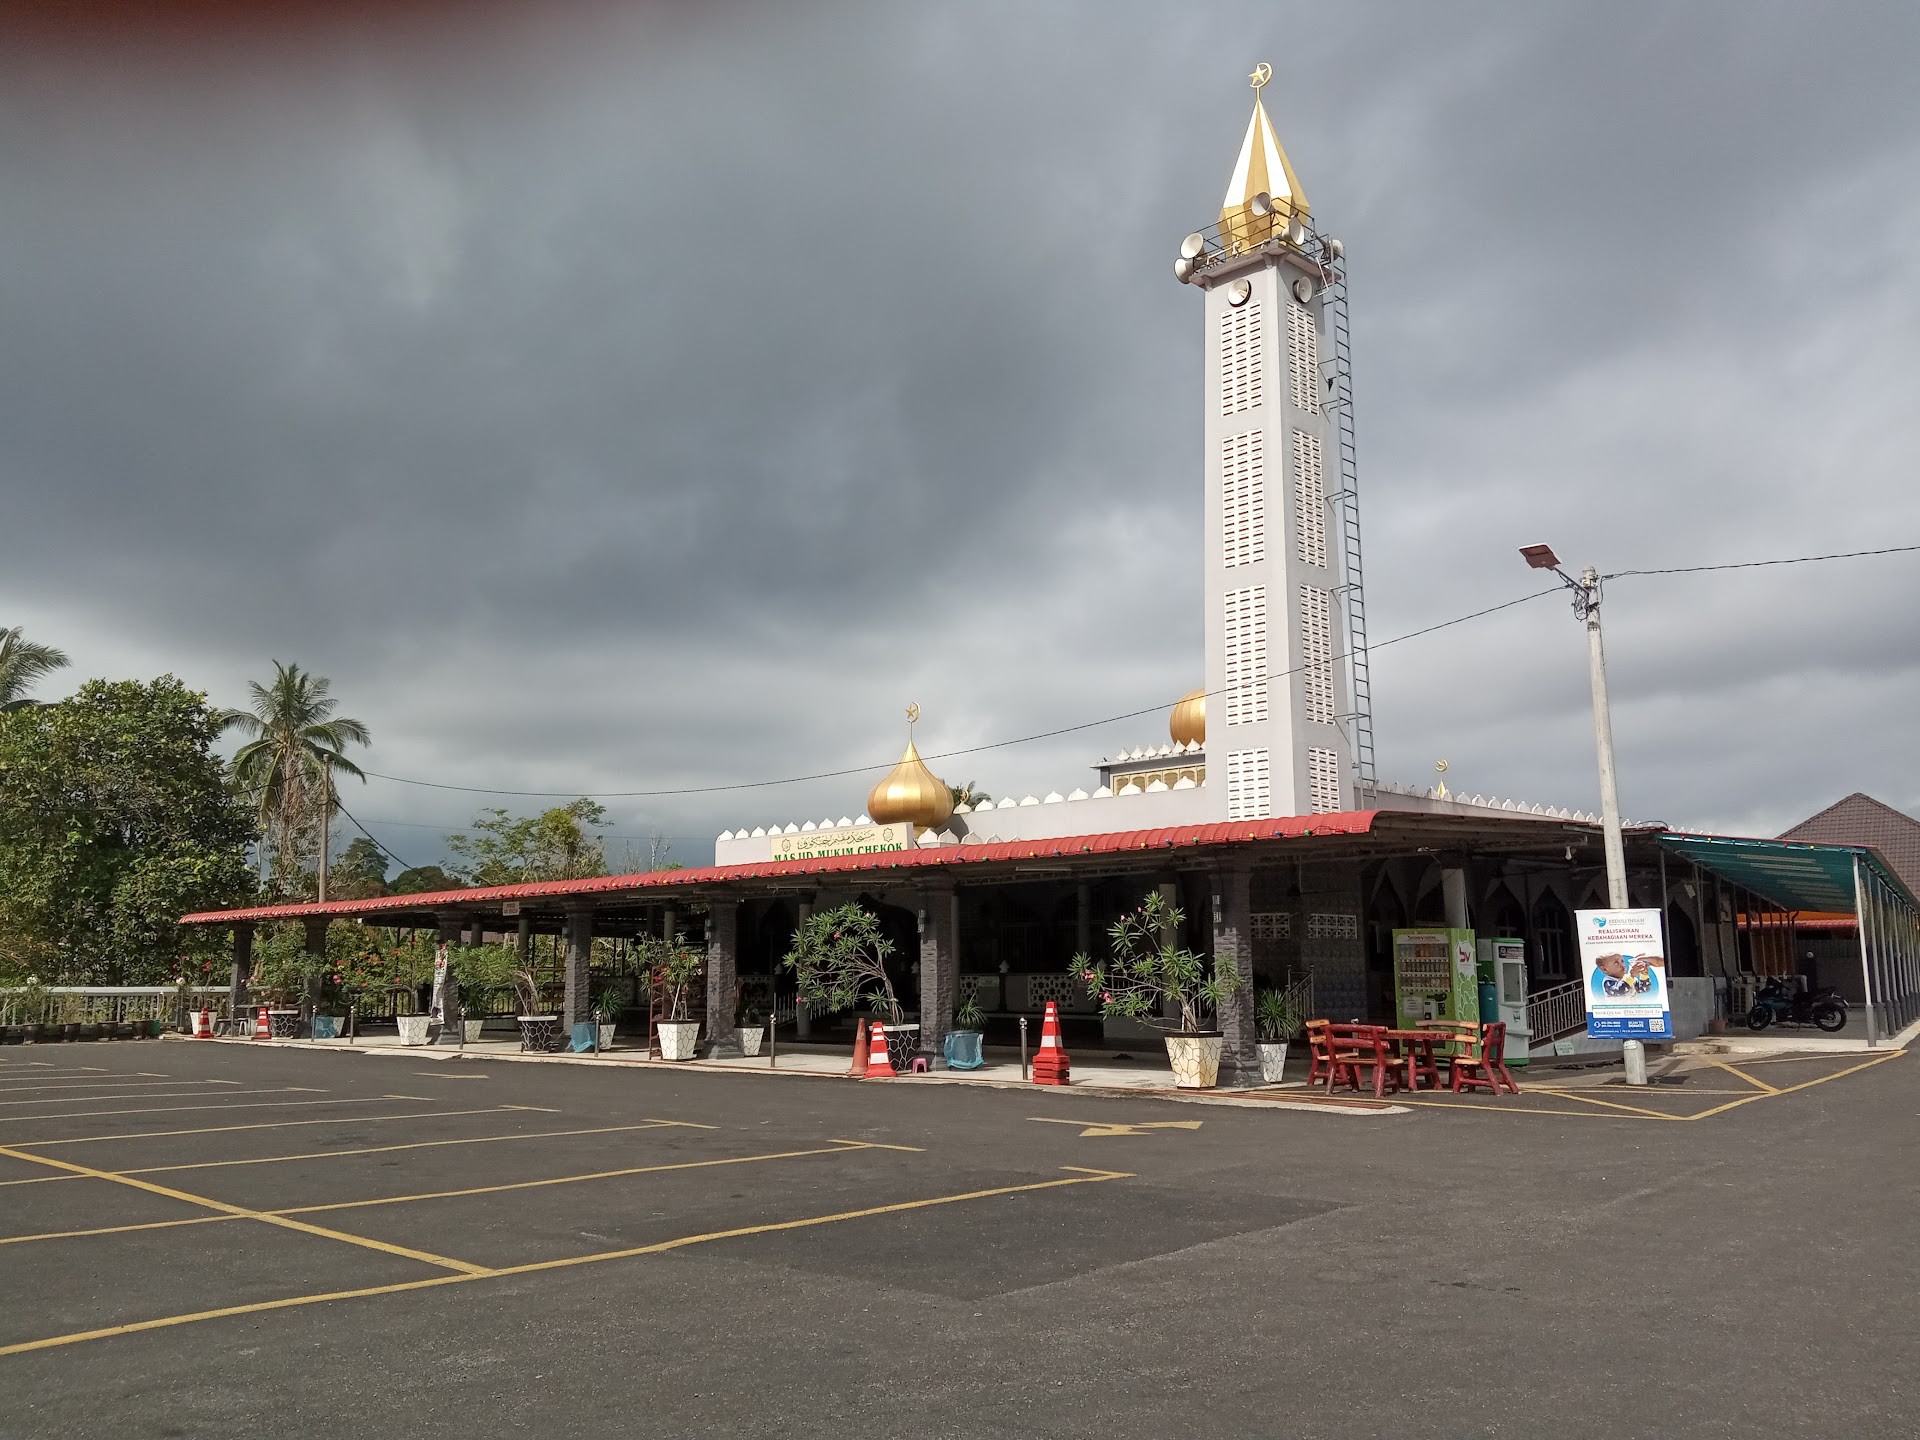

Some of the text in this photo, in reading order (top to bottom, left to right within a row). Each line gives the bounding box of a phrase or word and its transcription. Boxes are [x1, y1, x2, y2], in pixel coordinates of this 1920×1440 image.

[774, 842, 903, 861] MASJID MUKIM CHEKOK
